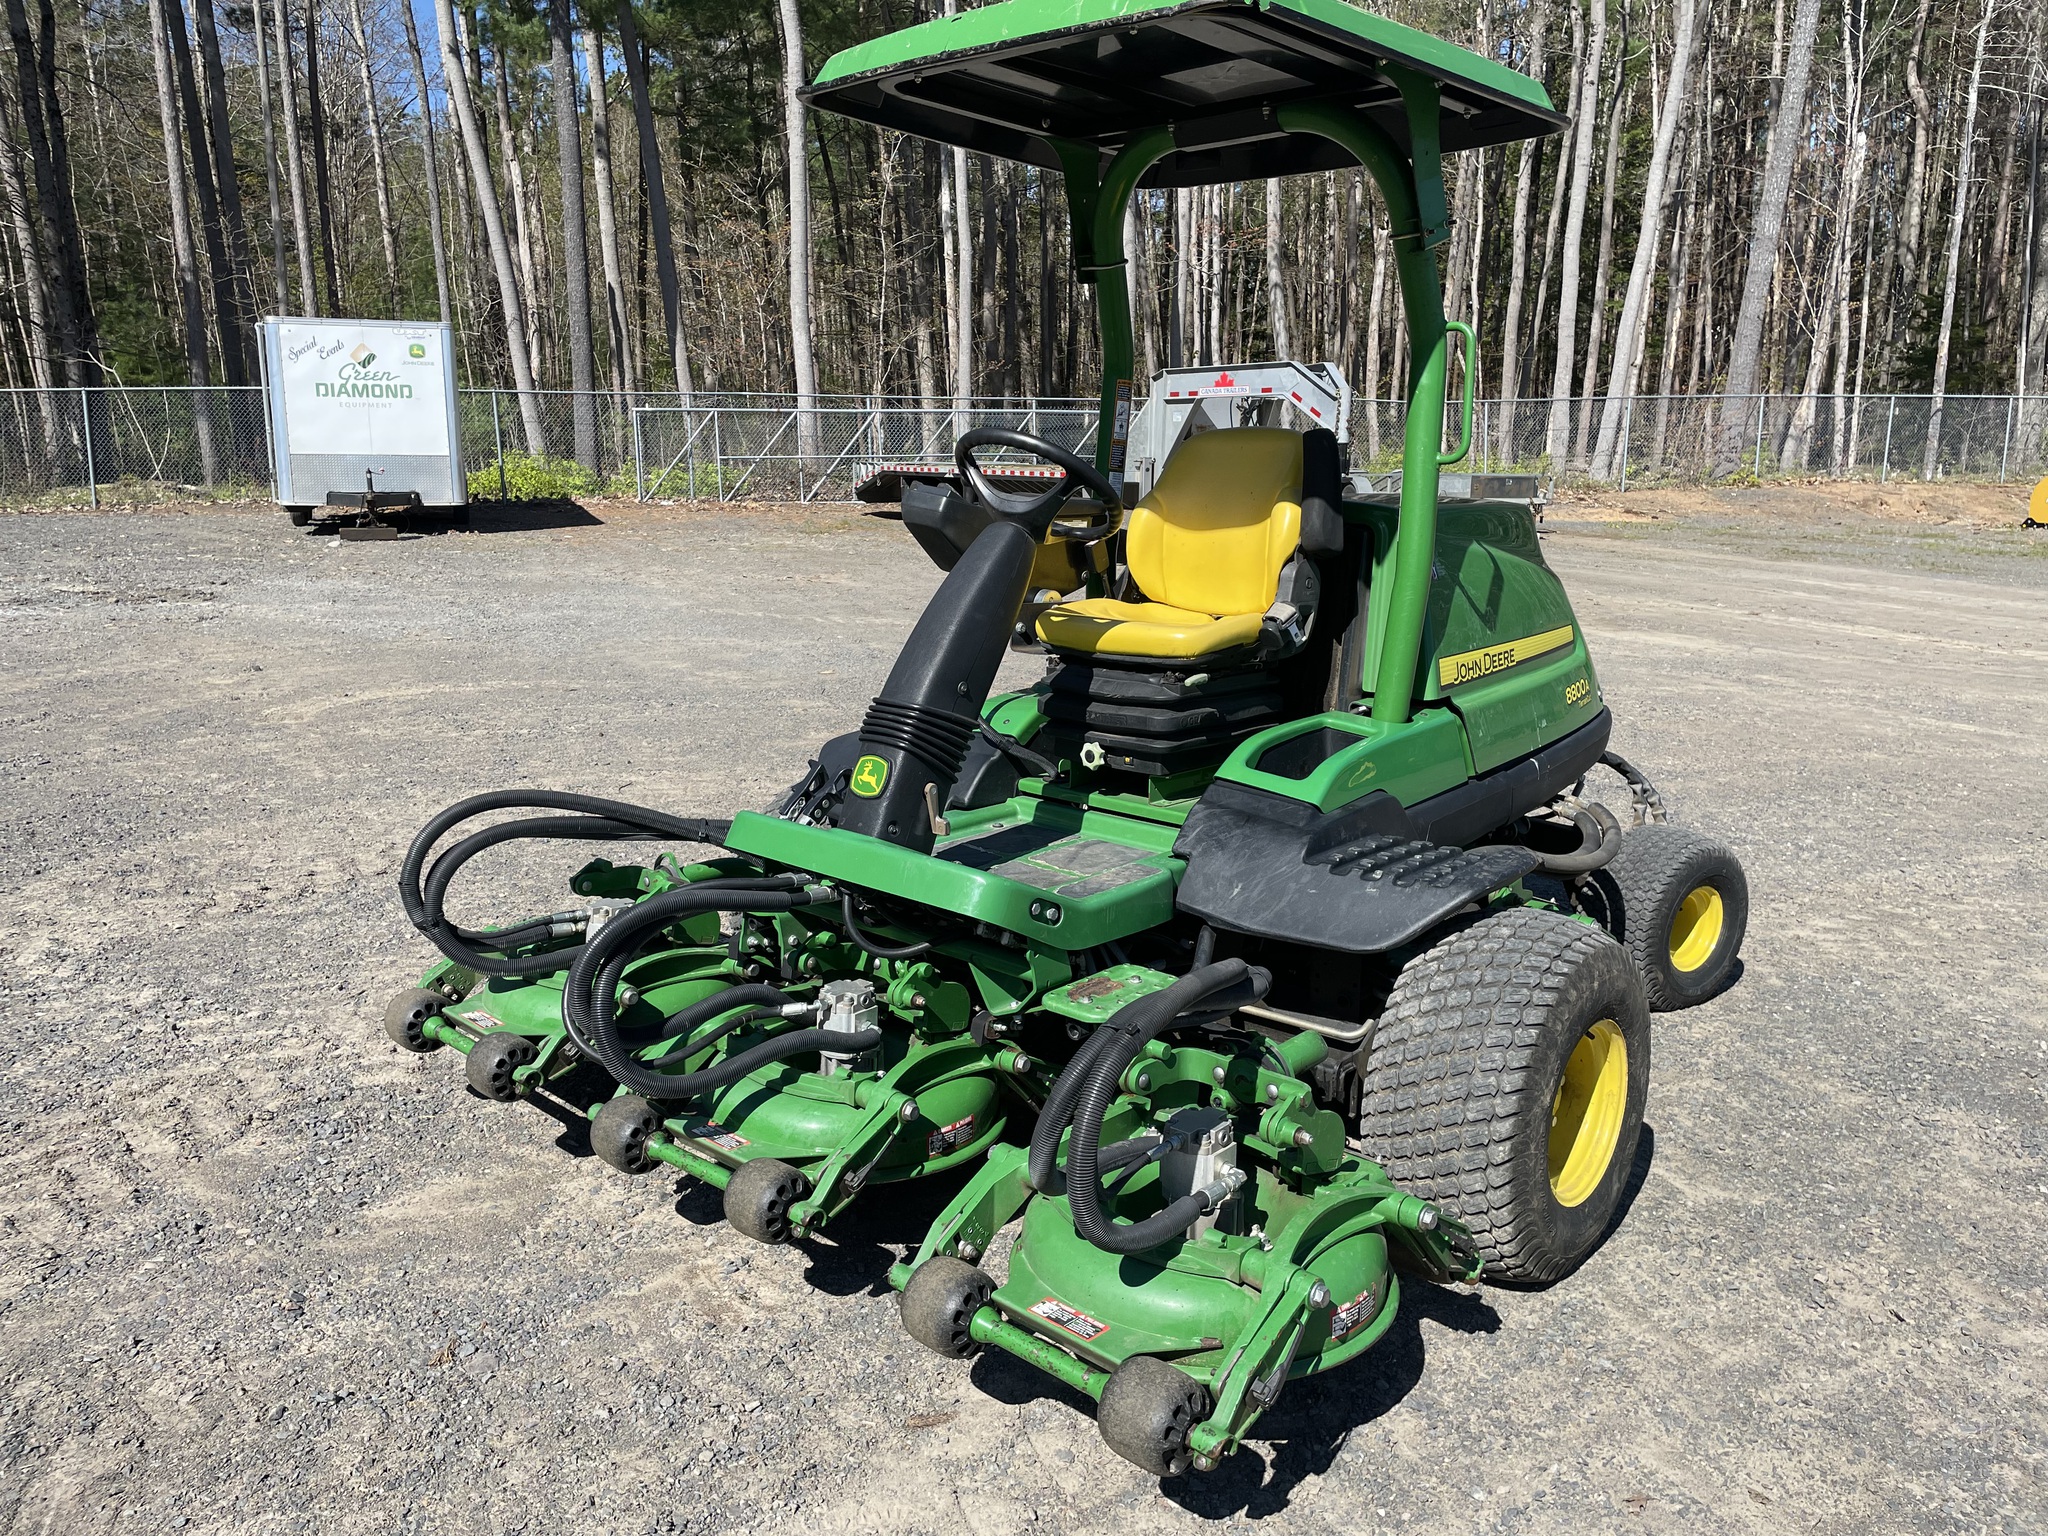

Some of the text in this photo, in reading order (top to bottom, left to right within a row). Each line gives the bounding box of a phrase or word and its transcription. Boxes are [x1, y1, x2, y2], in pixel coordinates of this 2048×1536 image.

[288, 335, 345, 363] Special Events
[338, 362, 400, 385] Green
[315, 382, 413, 399] DIAMOND
[339, 401, 393, 409] EQUIPMENT
[1454, 648, 1516, 683] JOHN DEERE
